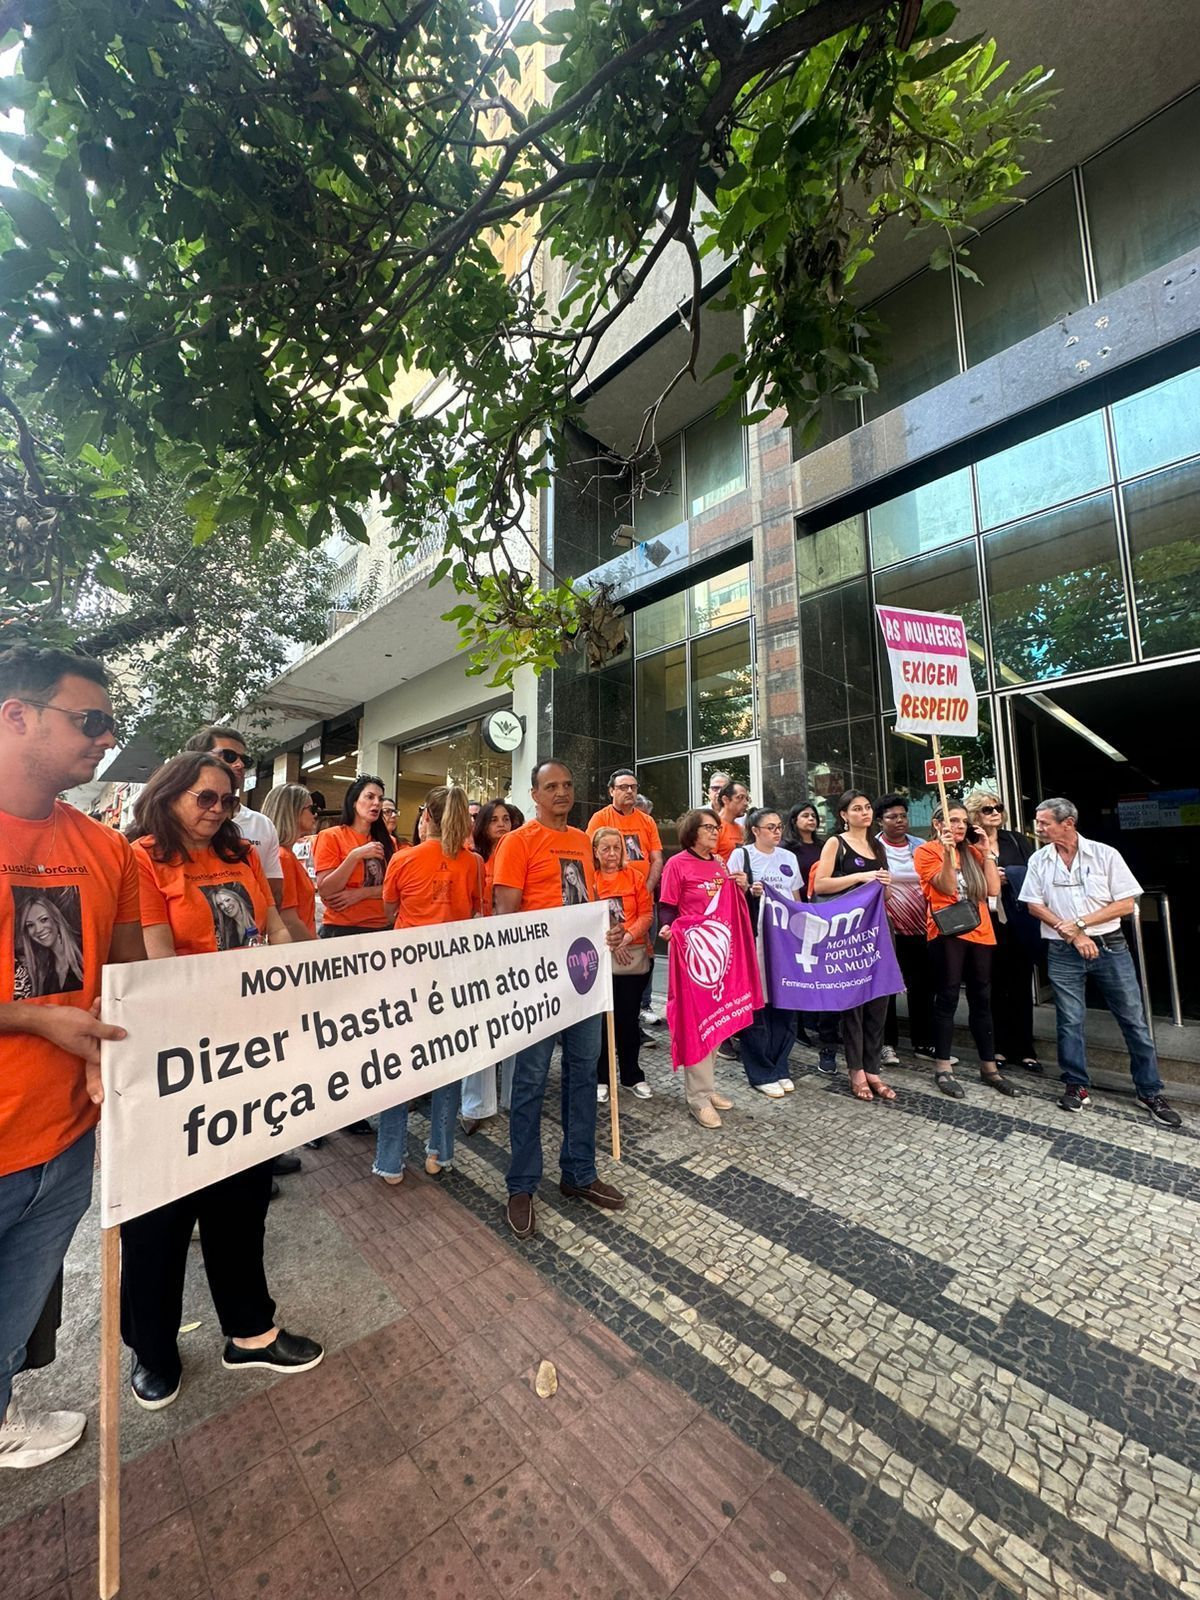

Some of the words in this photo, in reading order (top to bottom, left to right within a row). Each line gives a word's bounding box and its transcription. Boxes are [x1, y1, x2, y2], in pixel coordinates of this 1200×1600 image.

[886, 617, 900, 641] AS
[903, 621, 962, 649] MULHERES
[902, 660, 958, 686] EXIGEM
[900, 693, 969, 723] RESPEITO
[825, 943, 875, 961] POPULAR
[826, 926, 880, 950] MOVIMENT
[241, 951, 386, 997] MOVIMENTO
[391, 936, 471, 968] POPULAR
[473, 931, 495, 951] DA
[497, 922, 550, 947] MULHER
[825, 963, 843, 975] DA
[157, 1030, 289, 1097] Dizer
[301, 988, 418, 1049] 'basta'
[428, 981, 444, 1015] é
[451, 979, 491, 1009] um
[496, 966, 530, 996] ato
[535, 956, 559, 983] de
[714, 1014, 731, 1029] toda
[183, 1082, 316, 1156] força
[327, 1070, 350, 1102] e
[361, 1048, 402, 1090] de
[411, 1022, 480, 1071] amor
[486, 993, 561, 1049] próprio
